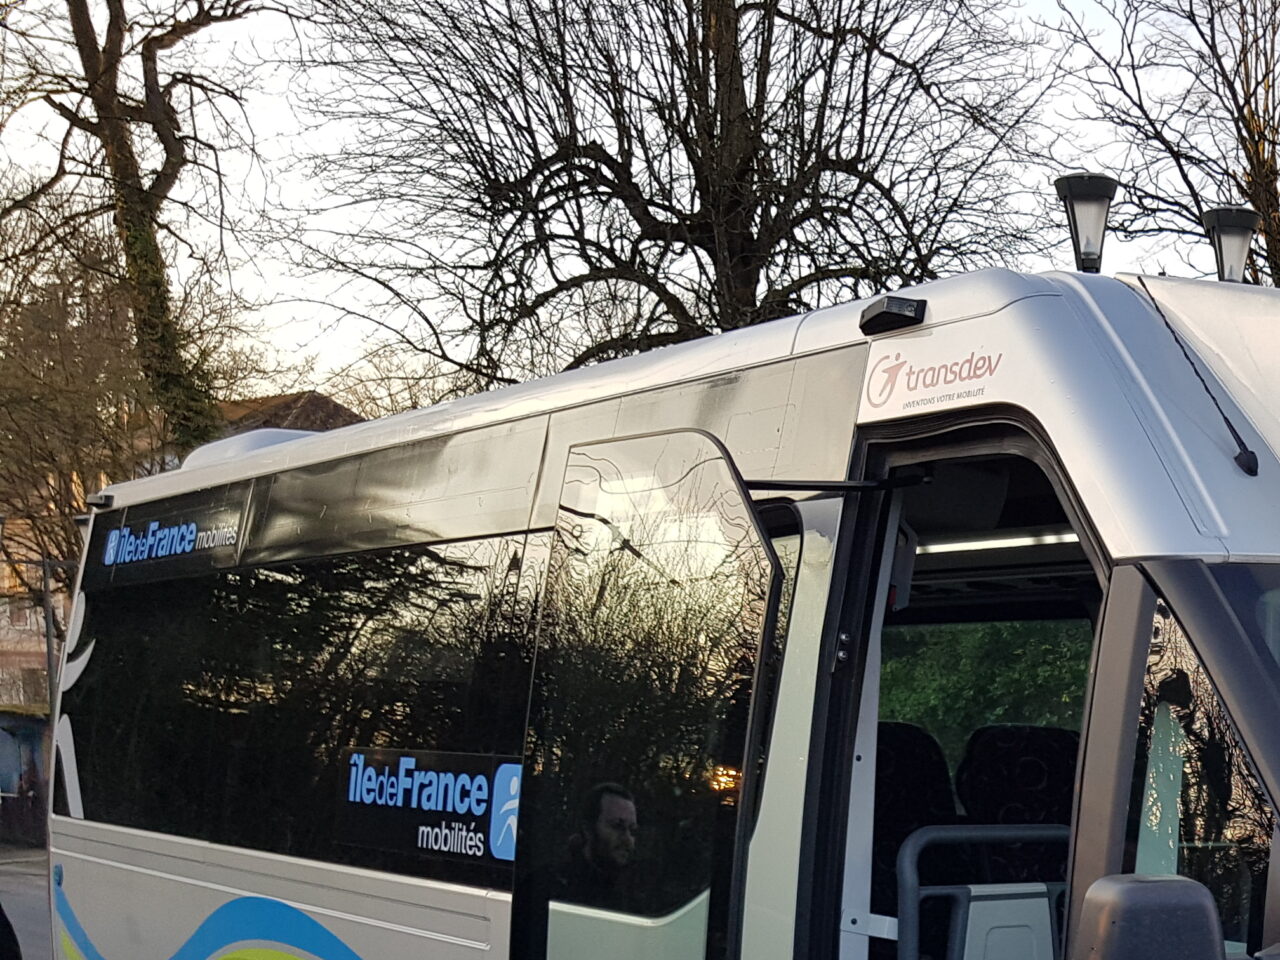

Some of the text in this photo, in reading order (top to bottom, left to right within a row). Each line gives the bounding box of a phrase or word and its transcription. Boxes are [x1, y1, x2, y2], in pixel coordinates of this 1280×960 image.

[906, 352, 1003, 392] transdev
[902, 395, 936, 410] INVENTONS
[936, 392, 956, 404] VOTRE
[196, 522, 237, 549] mobilités
[417, 821, 485, 857] mobilités
